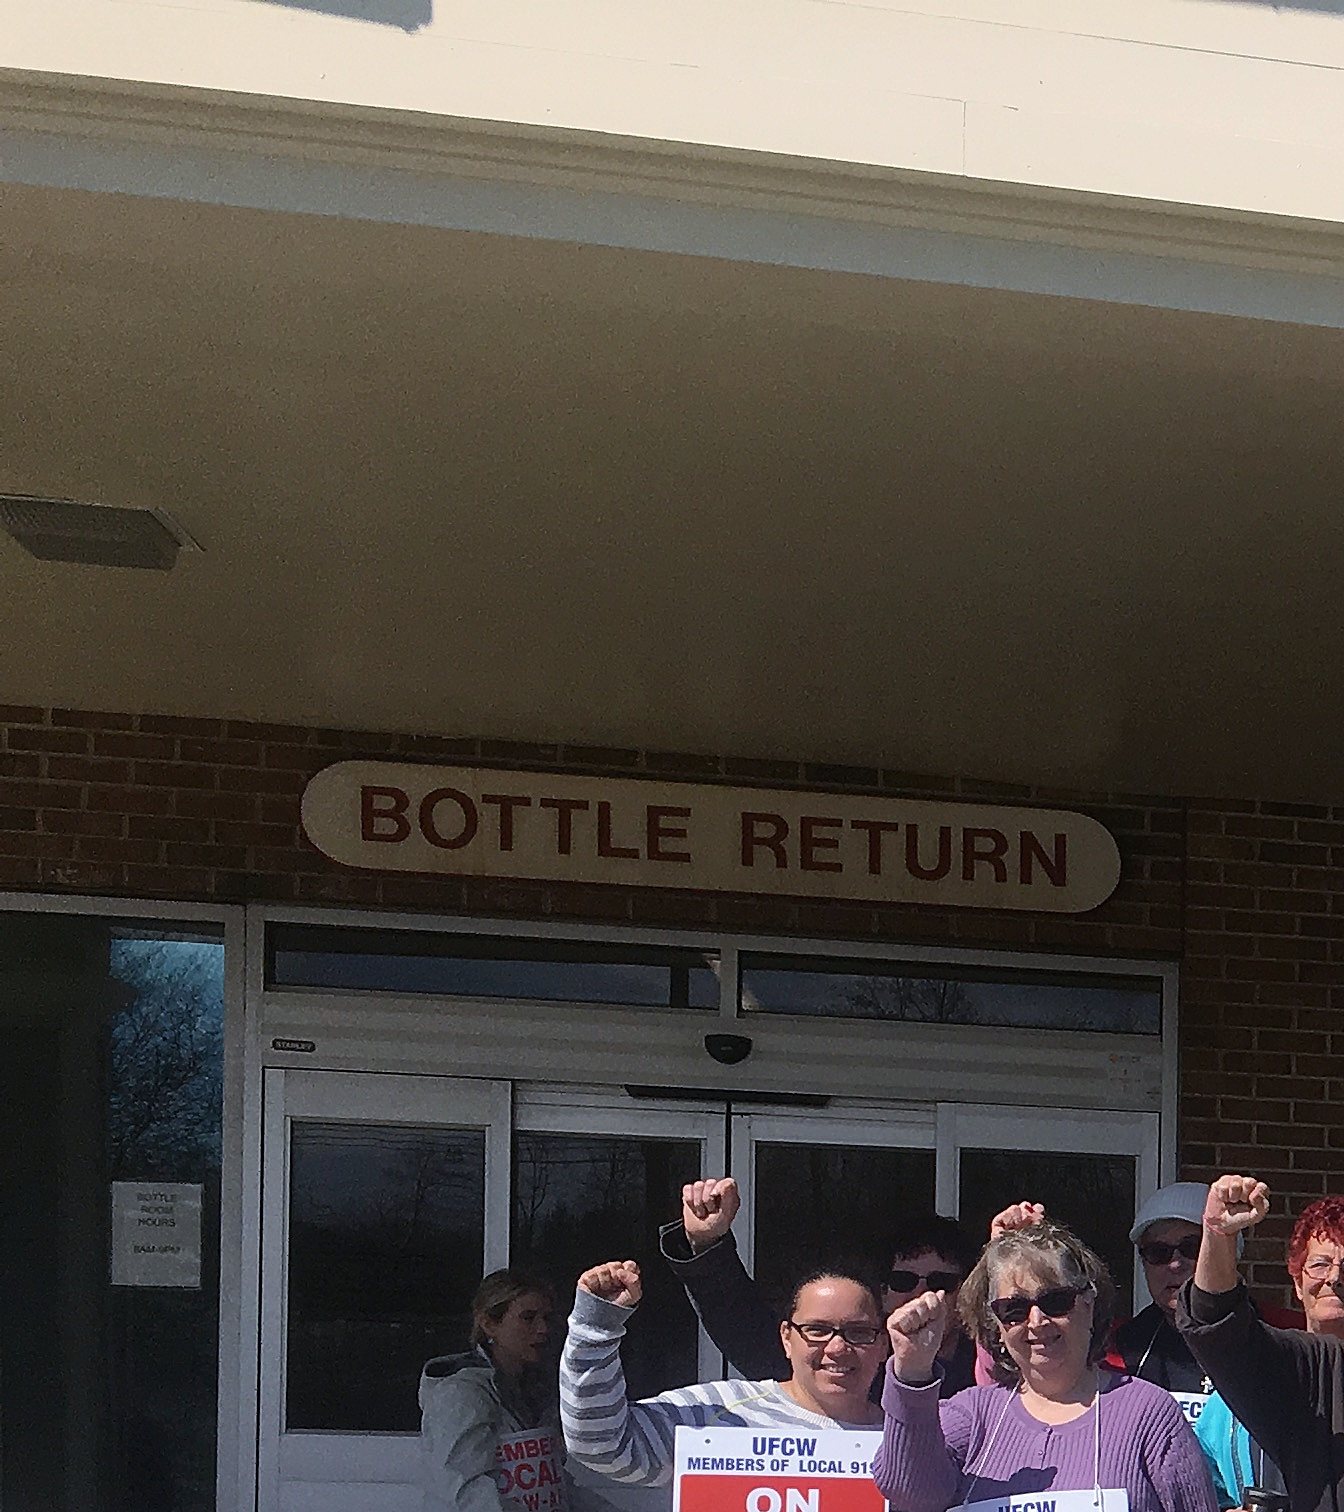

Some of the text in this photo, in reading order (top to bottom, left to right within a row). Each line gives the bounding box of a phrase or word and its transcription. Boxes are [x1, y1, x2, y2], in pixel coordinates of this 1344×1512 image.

[359, 784, 1068, 887] BOTTLE RETURN
[138, 1218, 177, 1228] HOURS
[752, 1437, 817, 1456] UFCW
[687, 1457, 767, 1471] MEMBERS
[771, 1458, 790, 1472] OF
[799, 1459, 846, 1474] LOCAL
